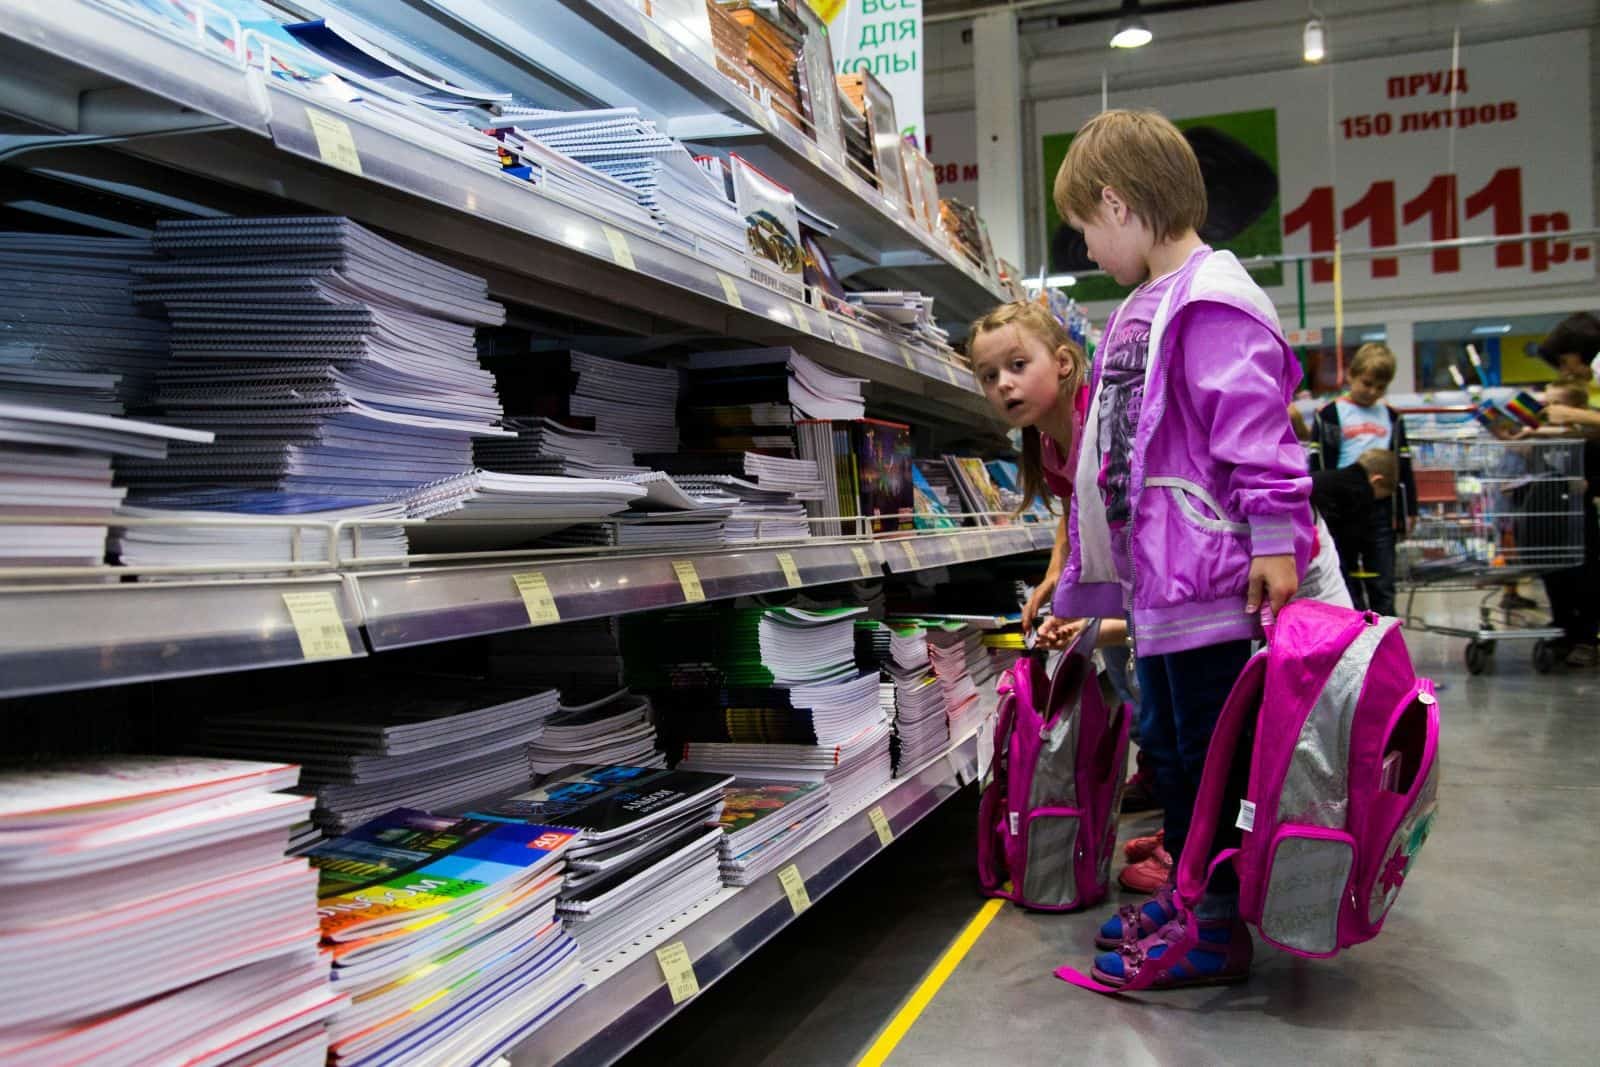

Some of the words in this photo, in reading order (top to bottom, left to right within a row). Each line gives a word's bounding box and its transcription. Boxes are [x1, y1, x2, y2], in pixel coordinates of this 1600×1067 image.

[858, 18, 916, 50] ДЛЯ
[836, 50, 916, 76] КОЛЫ
[1386, 67, 1470, 99] ПРУД
[1340, 112, 1393, 140] 150
[1399, 101, 1519, 134] литров
